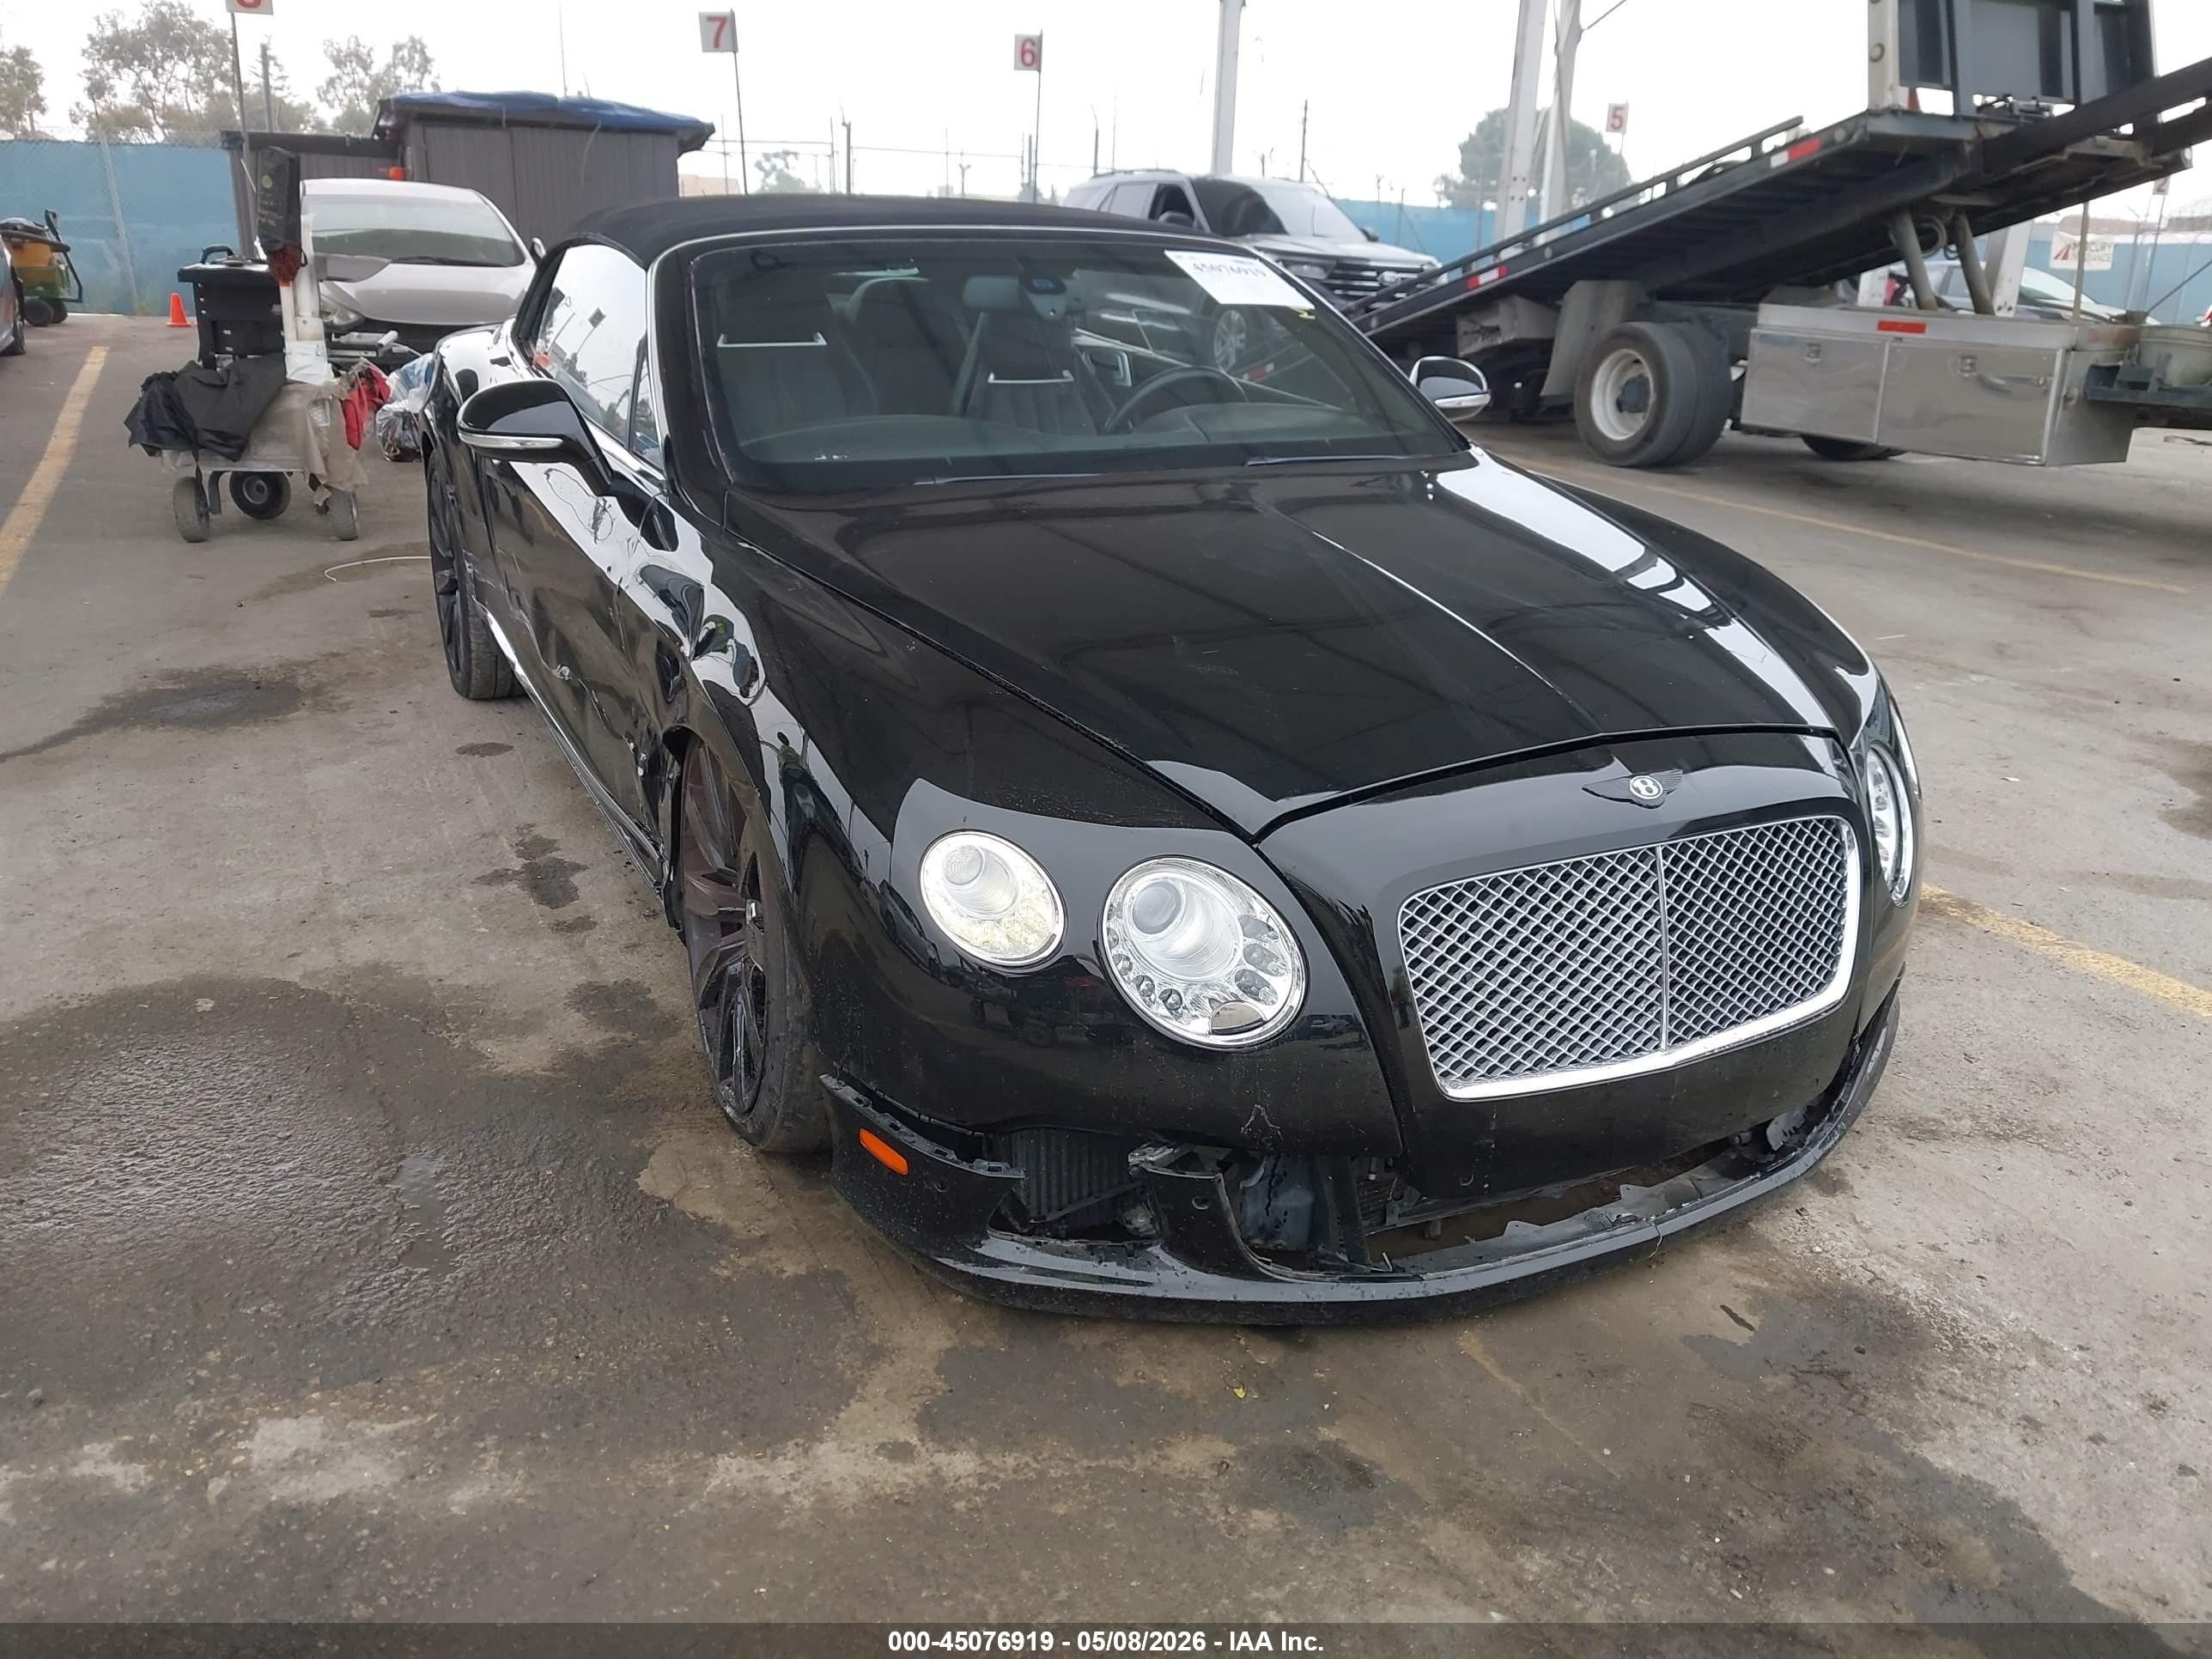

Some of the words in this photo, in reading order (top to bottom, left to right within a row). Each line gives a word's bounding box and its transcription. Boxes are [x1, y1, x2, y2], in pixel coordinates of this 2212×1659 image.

[706, 15, 728, 49] 7
[1020, 38, 1036, 68] 6
[1610, 106, 1626, 130] 5
